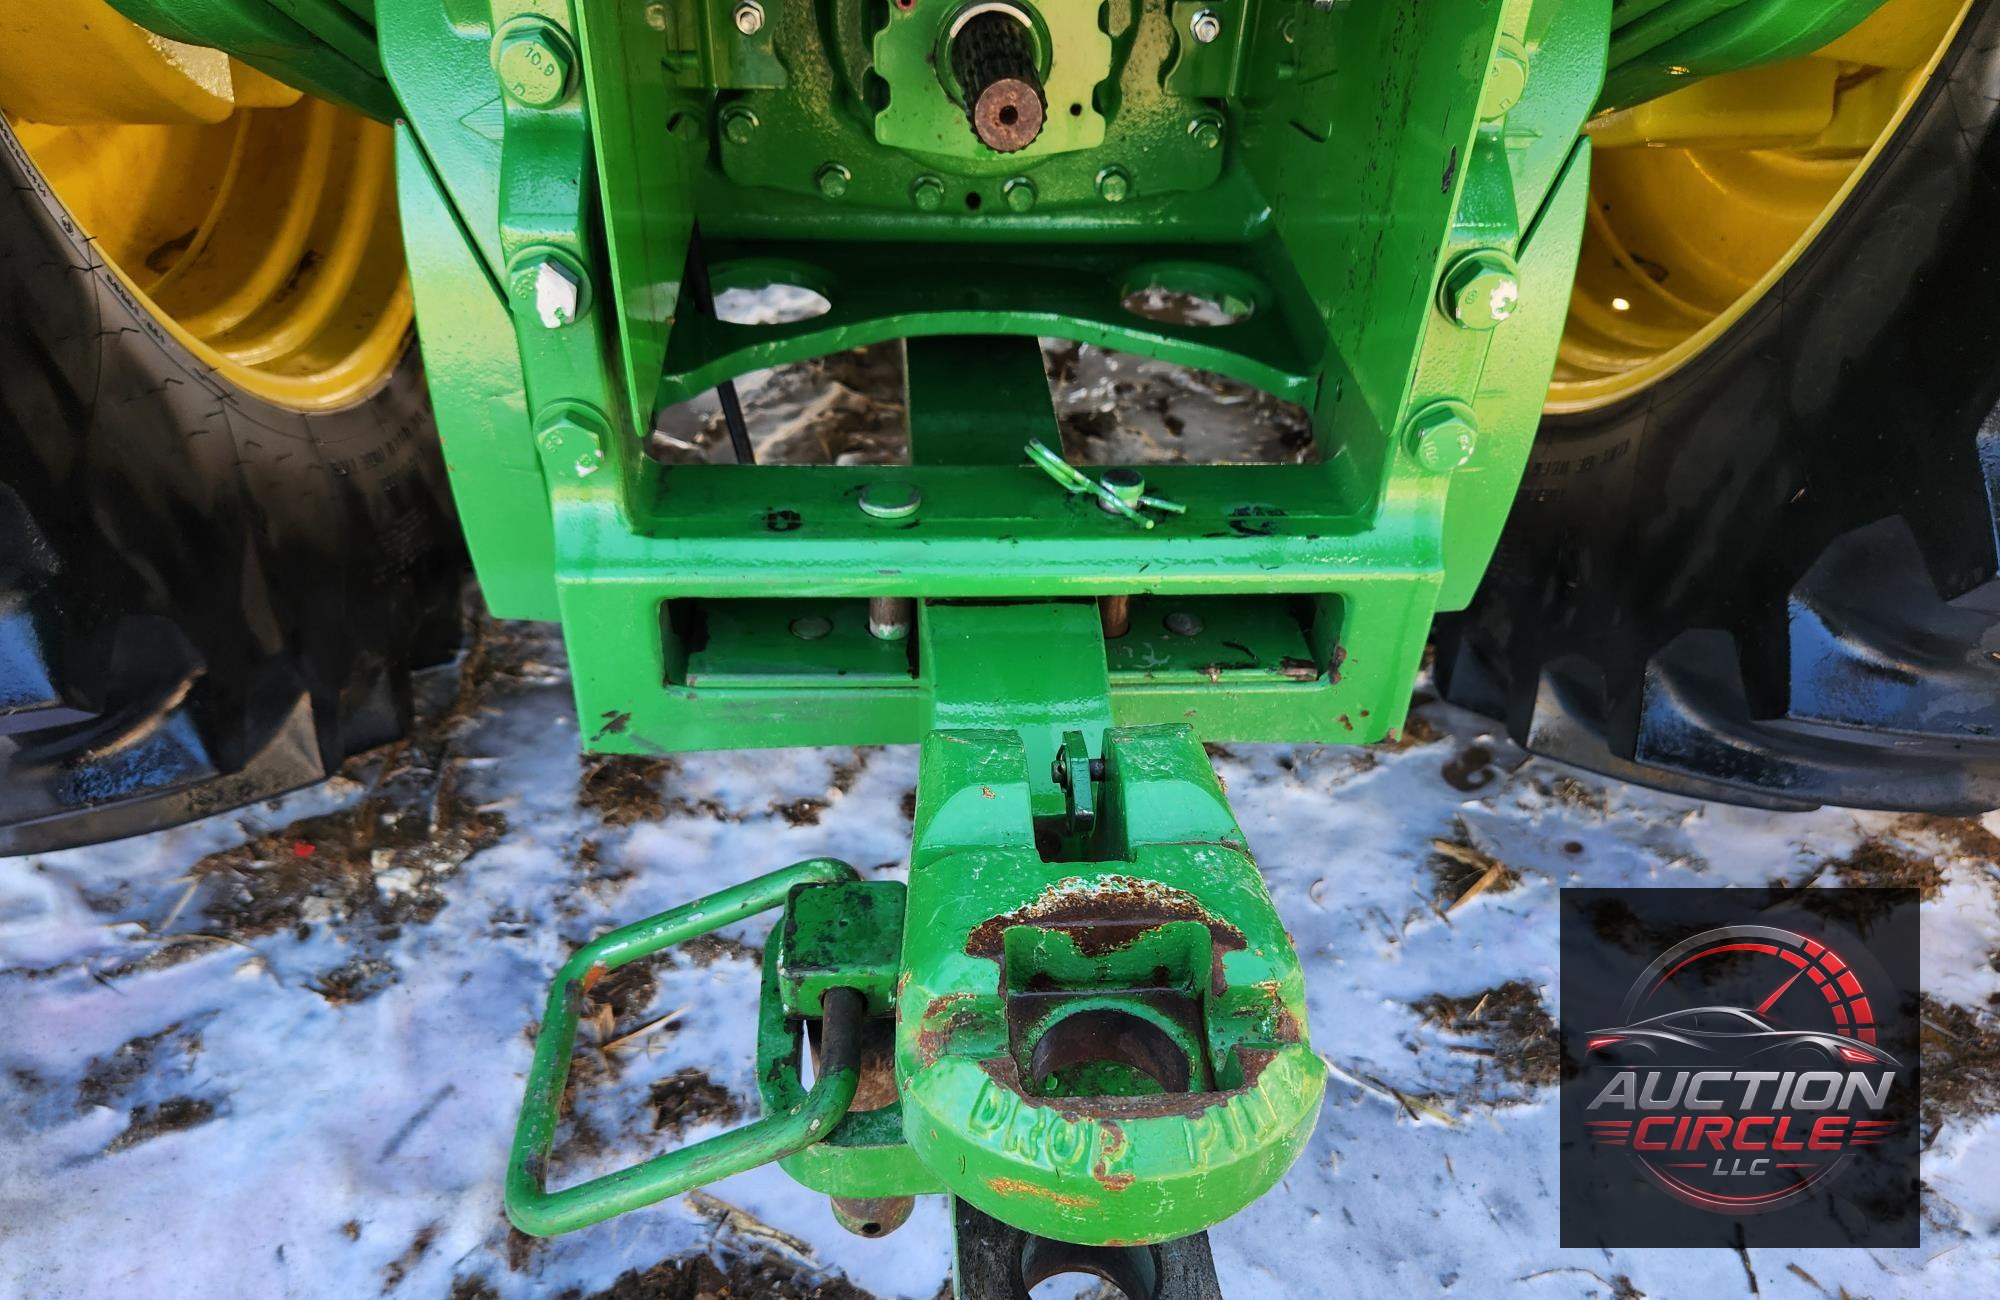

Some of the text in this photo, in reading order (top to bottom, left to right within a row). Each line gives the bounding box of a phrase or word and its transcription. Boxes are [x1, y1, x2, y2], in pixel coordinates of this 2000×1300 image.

[524, 46, 555, 76] 10.9
[969, 1075, 1280, 1179] DROP PIN
